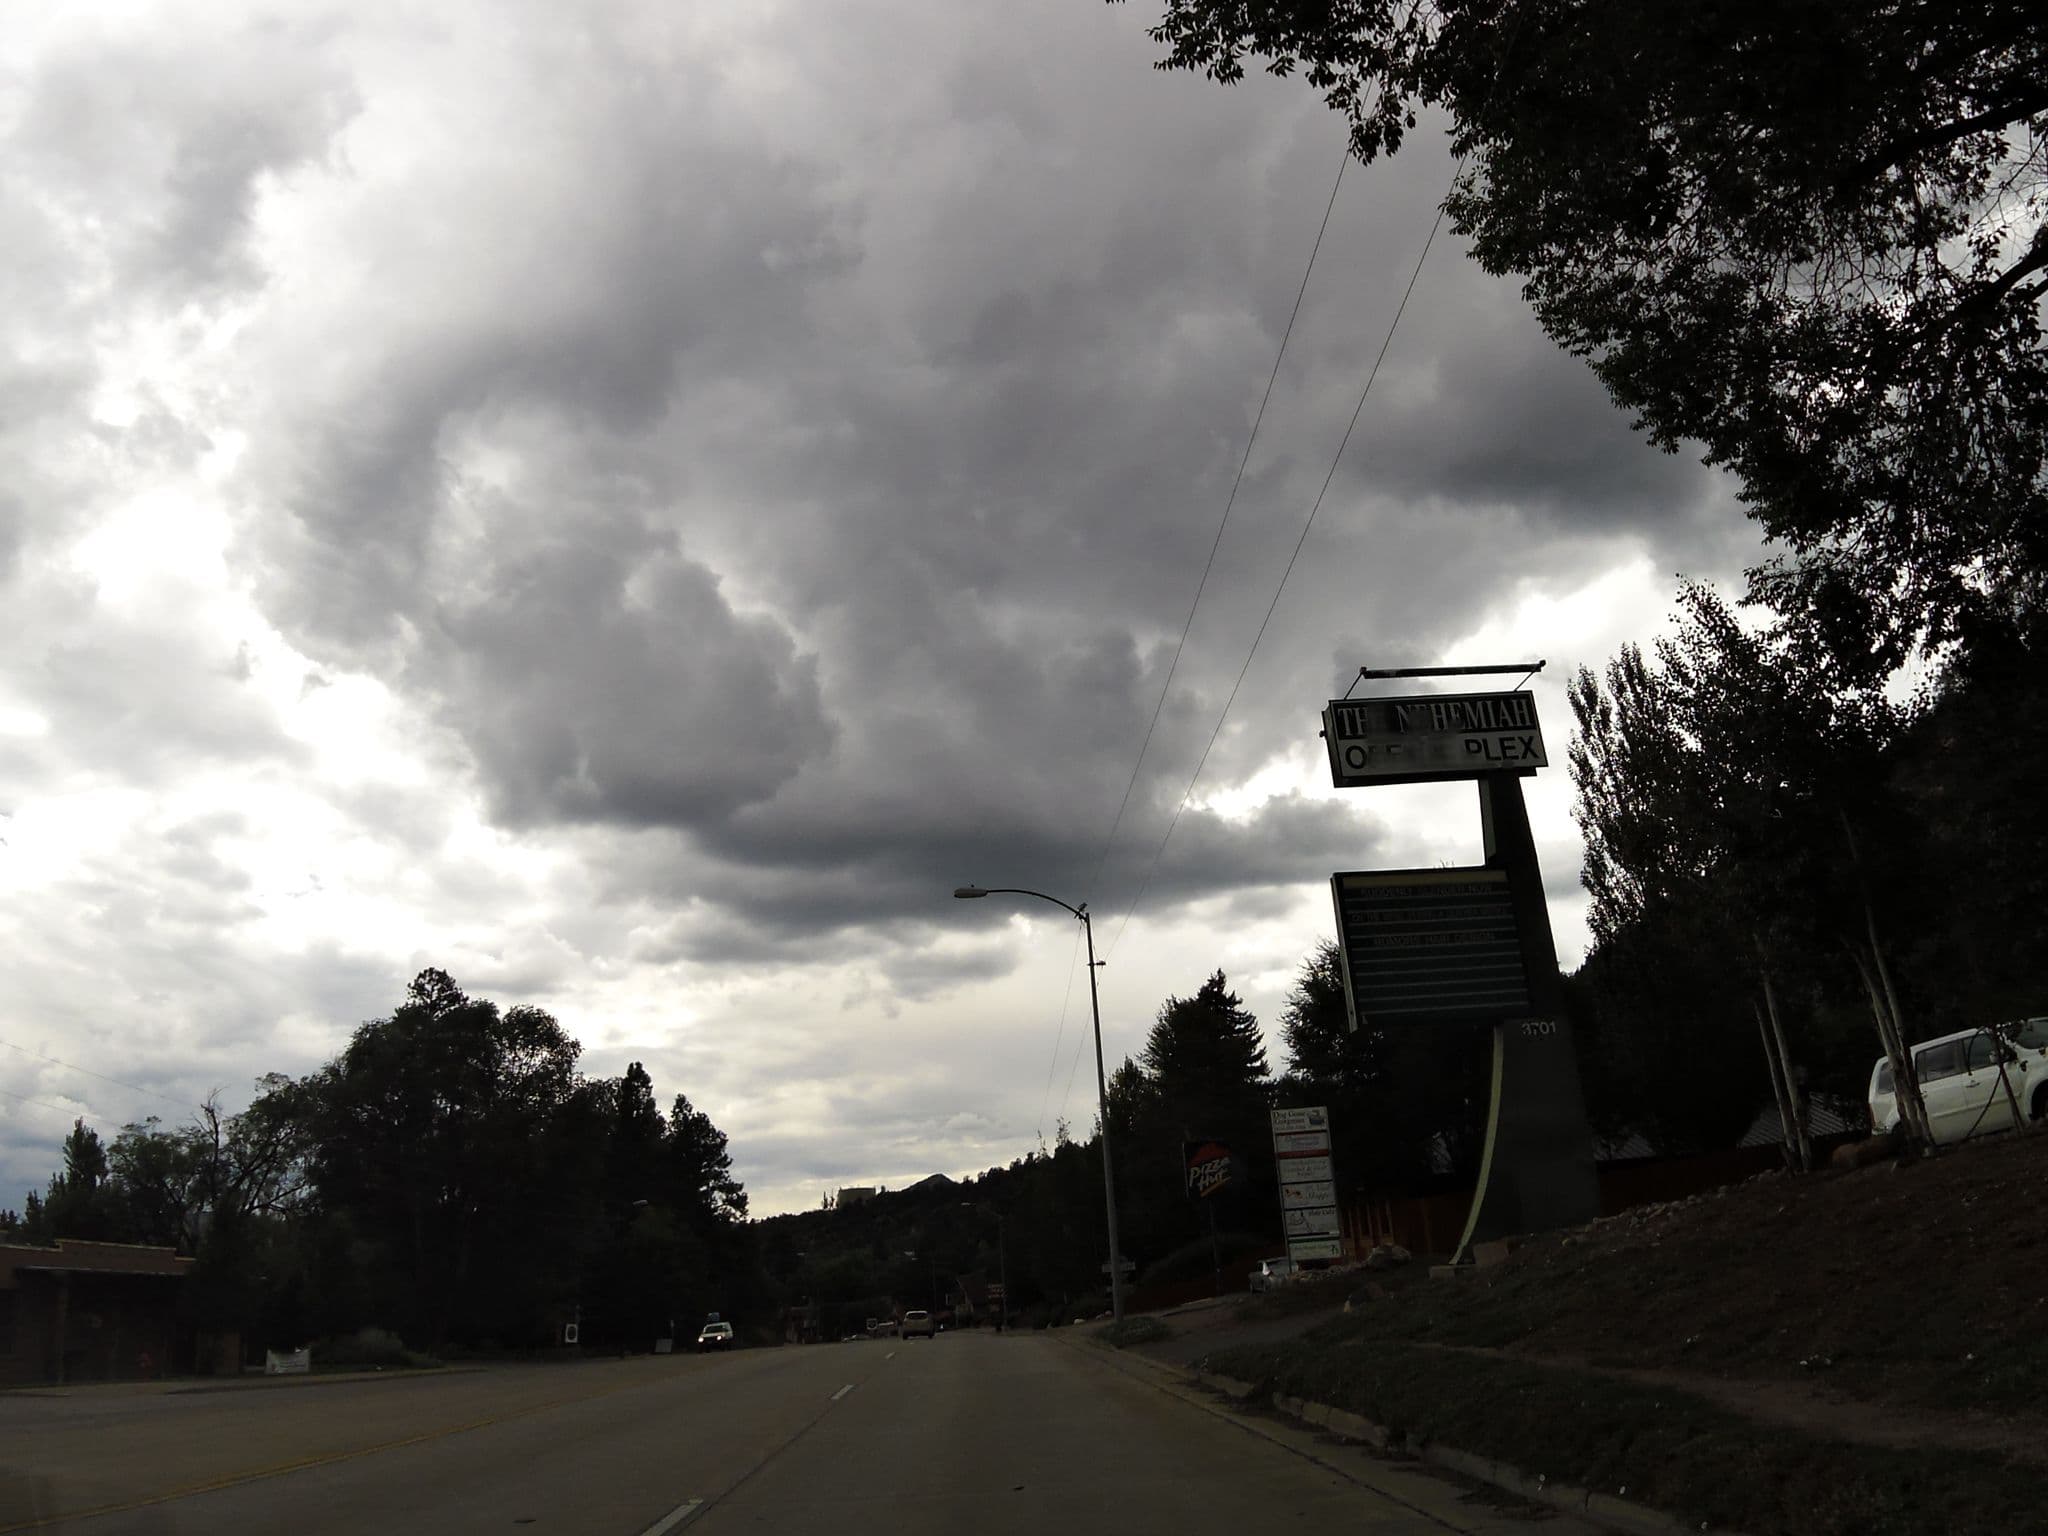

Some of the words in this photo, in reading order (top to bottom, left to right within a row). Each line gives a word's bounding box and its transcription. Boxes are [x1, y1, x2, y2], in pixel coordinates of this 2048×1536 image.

[1521, 1021, 1556, 1035] 3701
[1189, 1157, 1232, 1187] Pizza
[1198, 1168, 1230, 1191] Hut
